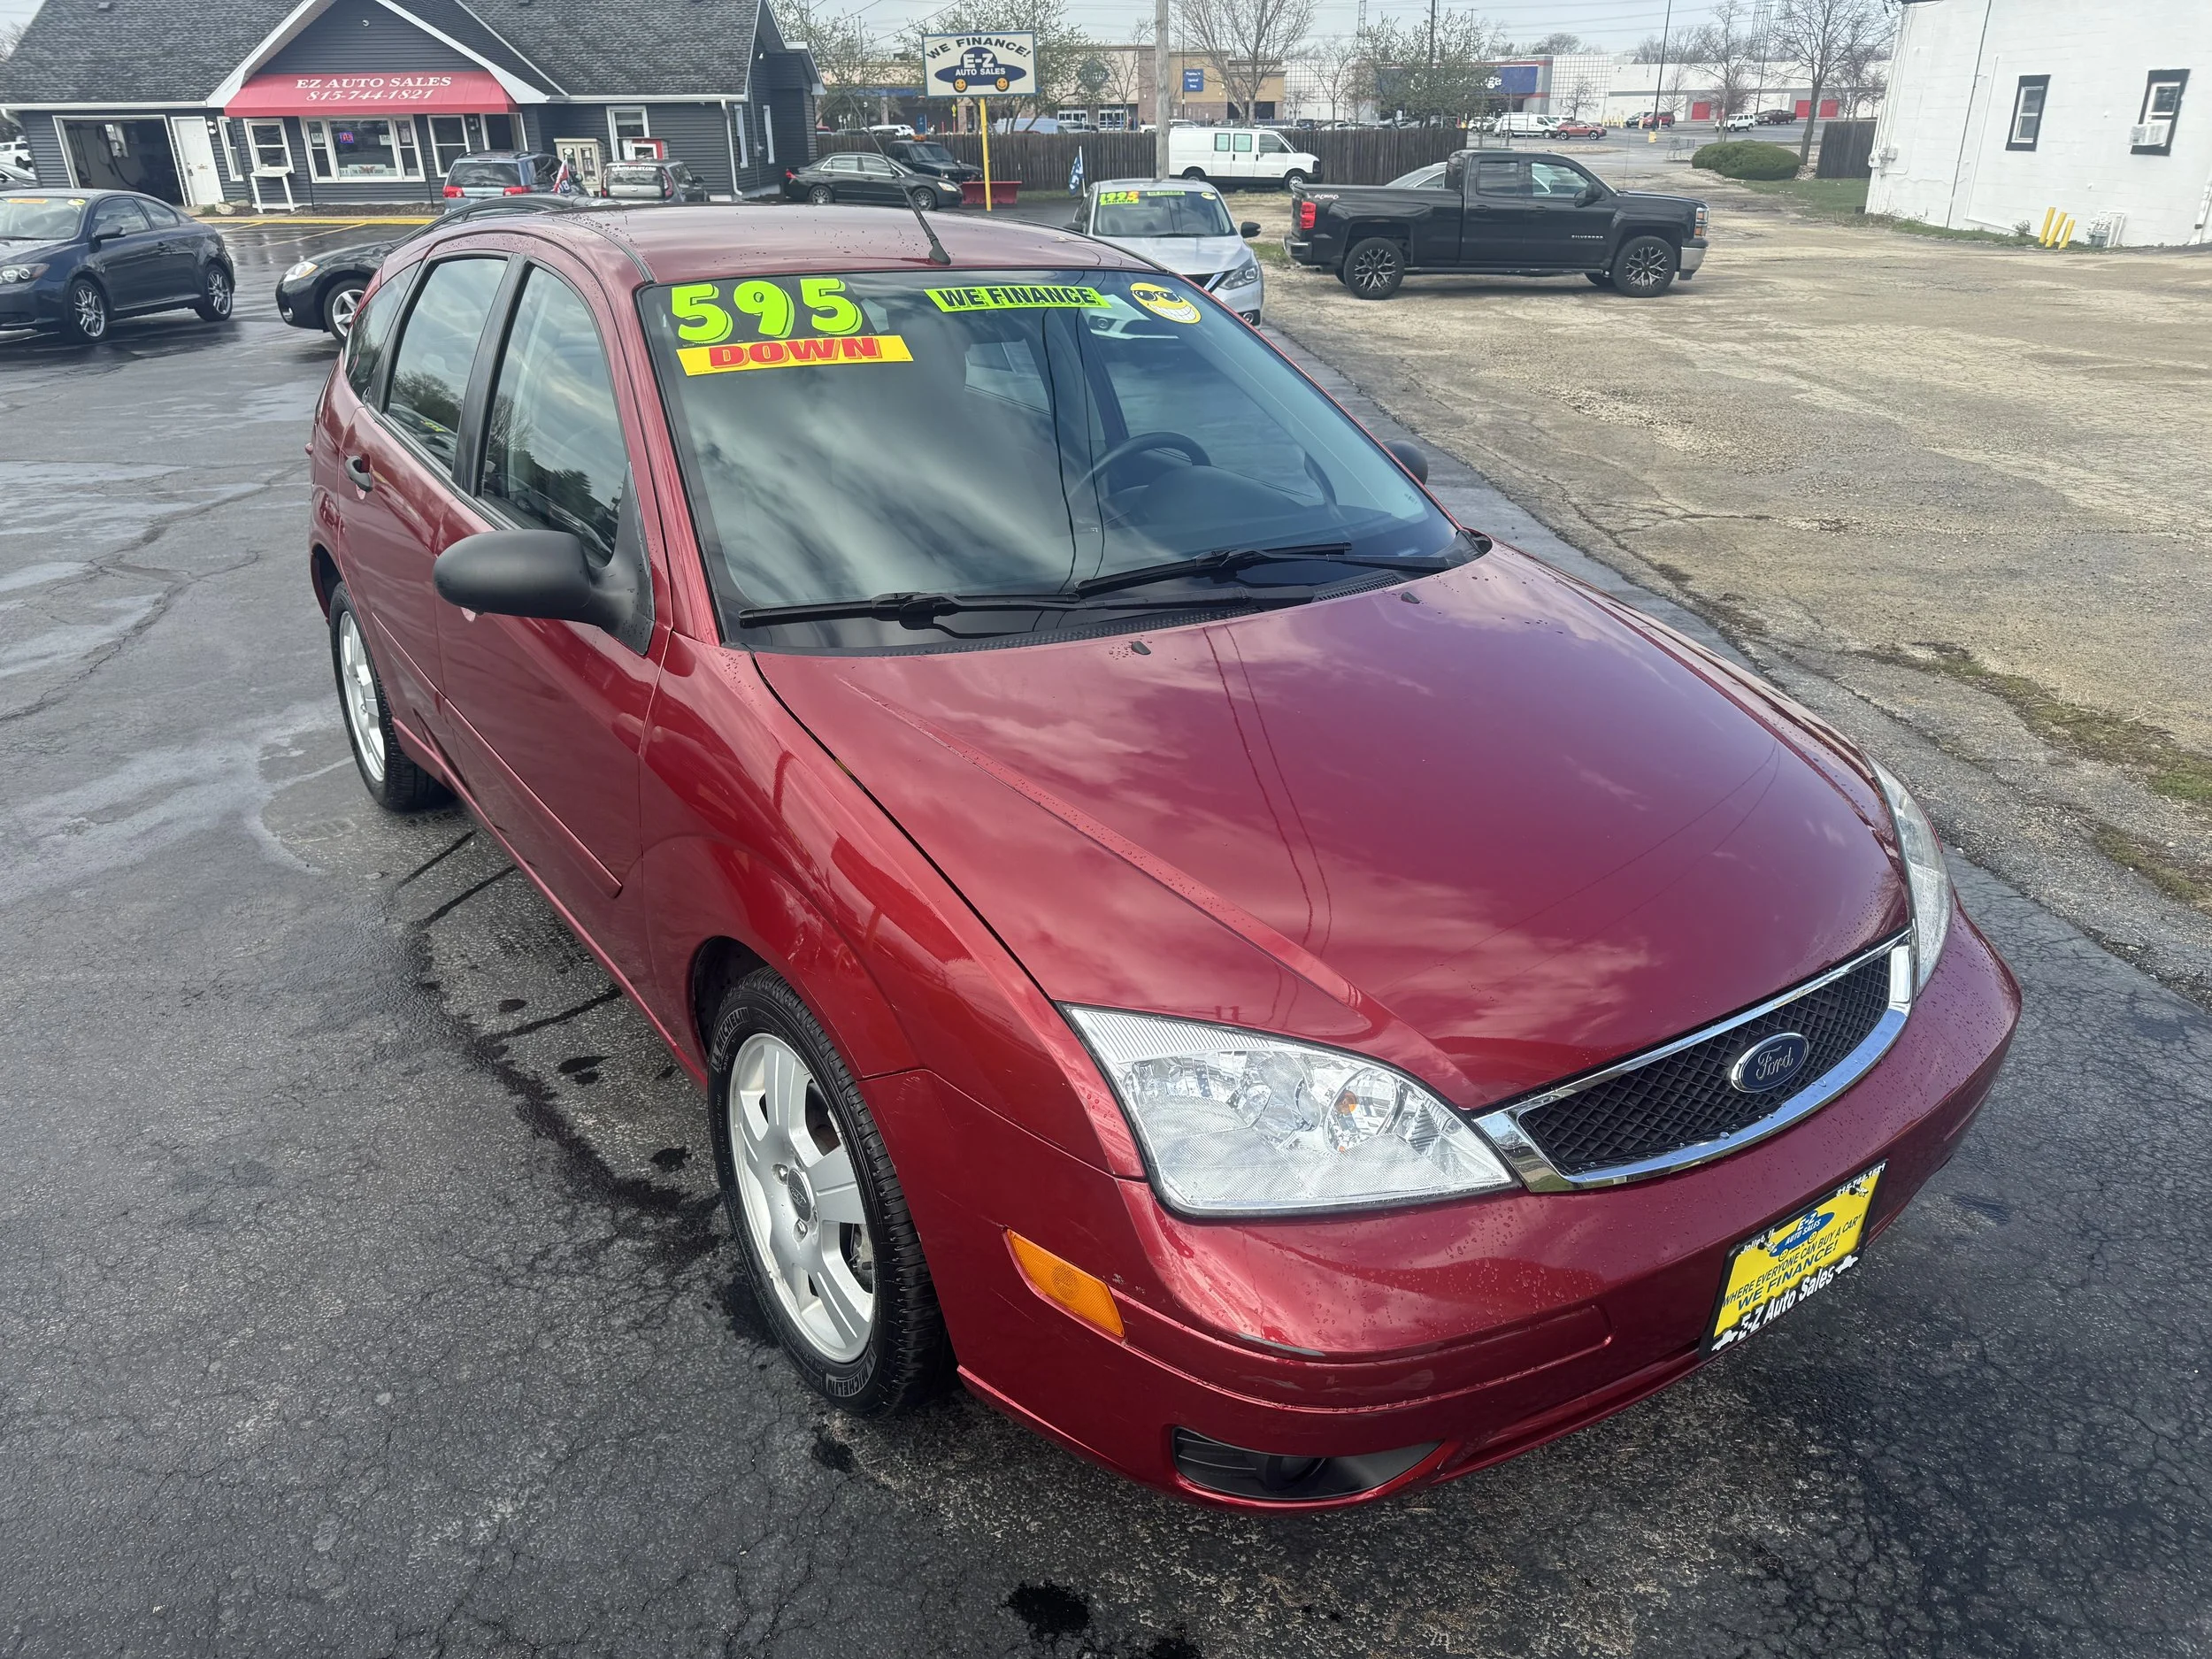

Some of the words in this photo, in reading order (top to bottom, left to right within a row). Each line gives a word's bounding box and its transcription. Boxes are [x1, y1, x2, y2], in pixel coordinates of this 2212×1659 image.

[926, 43, 951, 59] WE
[956, 36, 1032, 58] FINANCE!
[964, 53, 995, 68] E-Z
[296, 79, 321, 88] EZ
[326, 78, 384, 88] AUTO
[389, 76, 451, 87] SALES
[306, 88, 433, 101] 815-744-1821
[672, 278, 863, 344] 595
[936, 288, 989, 308] WE
[985, 287, 1101, 306] FINANCE
[709, 337, 882, 369] DOWN
[1755, 1045, 1793, 1080] Ford
[1785, 1230, 1802, 1246] AUTO
[1802, 1218, 1822, 1235] SALES
[1797, 1211, 1818, 1232] E-Z
[1755, 1251, 1800, 1288] EVERYONE
[1801, 1240, 1817, 1260] CAN
[1817, 1230, 1836, 1249] BUY
[1834, 1226, 1841, 1239] A
[1739, 1286, 1764, 1311] WE
[1767, 1239, 1839, 1294] FINANCE!
[1737, 1304, 1764, 1341] E-Z
[1763, 1286, 1797, 1325] Auto
[1799, 1265, 1836, 1302] Sales
